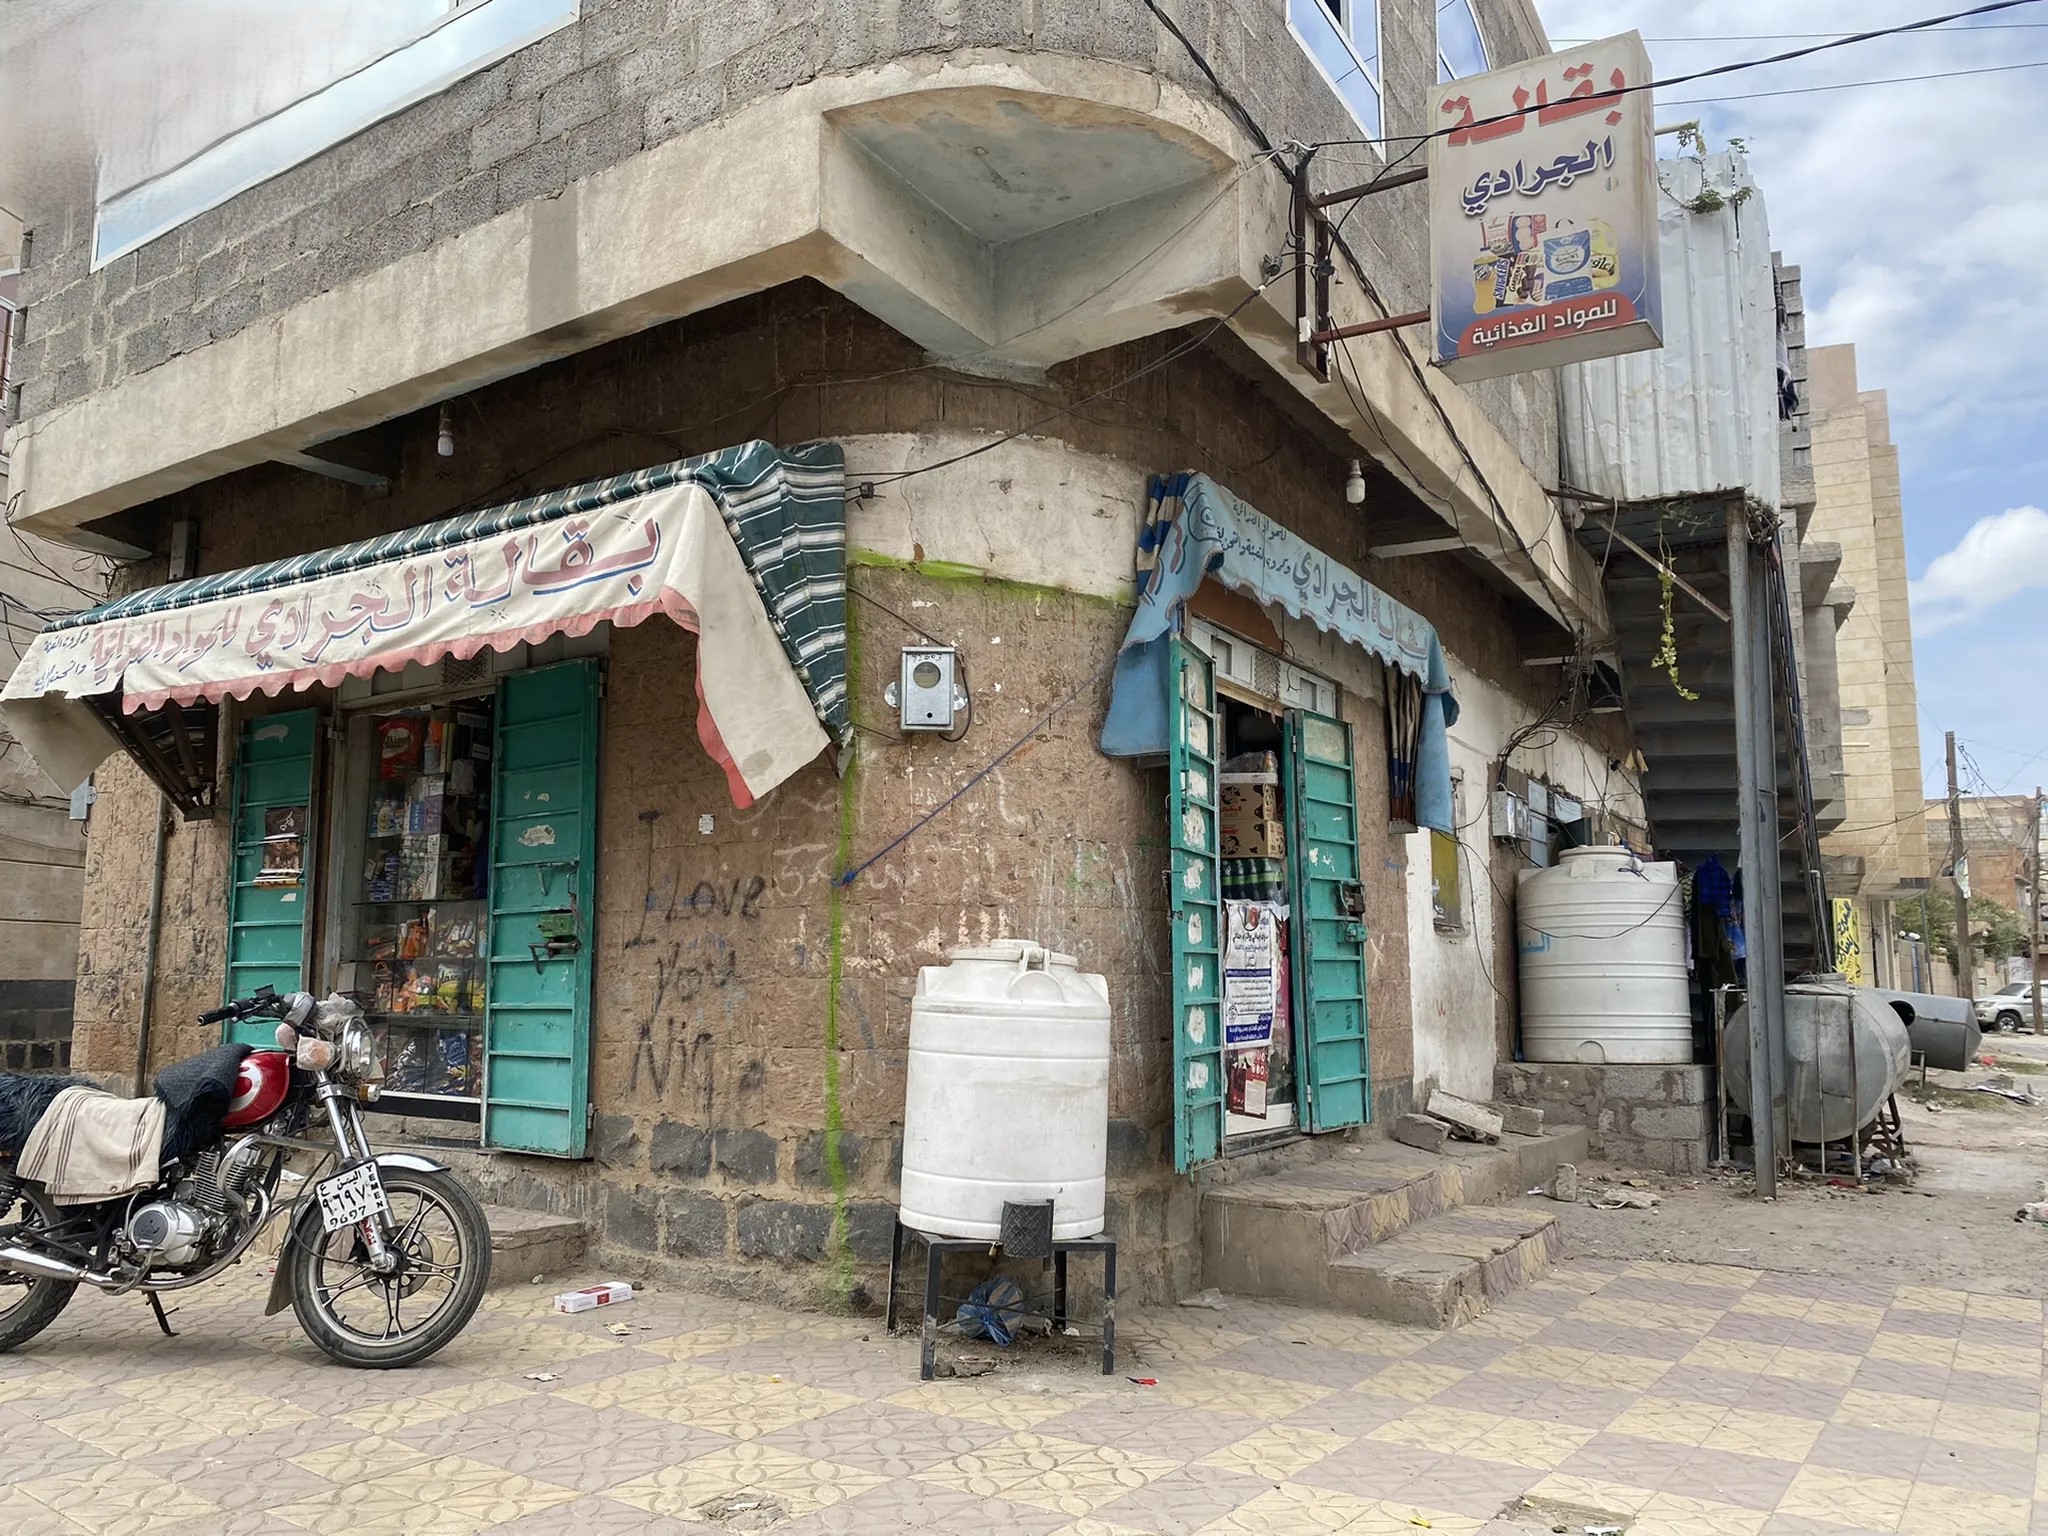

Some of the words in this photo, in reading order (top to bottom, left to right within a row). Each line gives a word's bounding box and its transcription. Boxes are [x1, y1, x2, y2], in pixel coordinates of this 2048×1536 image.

[1441, 62, 1626, 147] بقالة
[1461, 135, 1616, 216] الجرادي
[1493, 258, 1510, 299] SNICKERS
[1472, 312, 1546, 348] الغذائية
[1554, 297, 1618, 330] للمواد
[443, 517, 661, 611] بقالة
[1292, 551, 1370, 622] الجرادي
[162, 605, 243, 672] للمواد
[244, 564, 434, 672] الجرادي
[322, 1184, 366, 1217] ٩٦٩٧
[336, 1169, 362, 1191] اليمن
[365, 1164, 385, 1209] YEMEN
[329, 1205, 367, 1228] 9697
